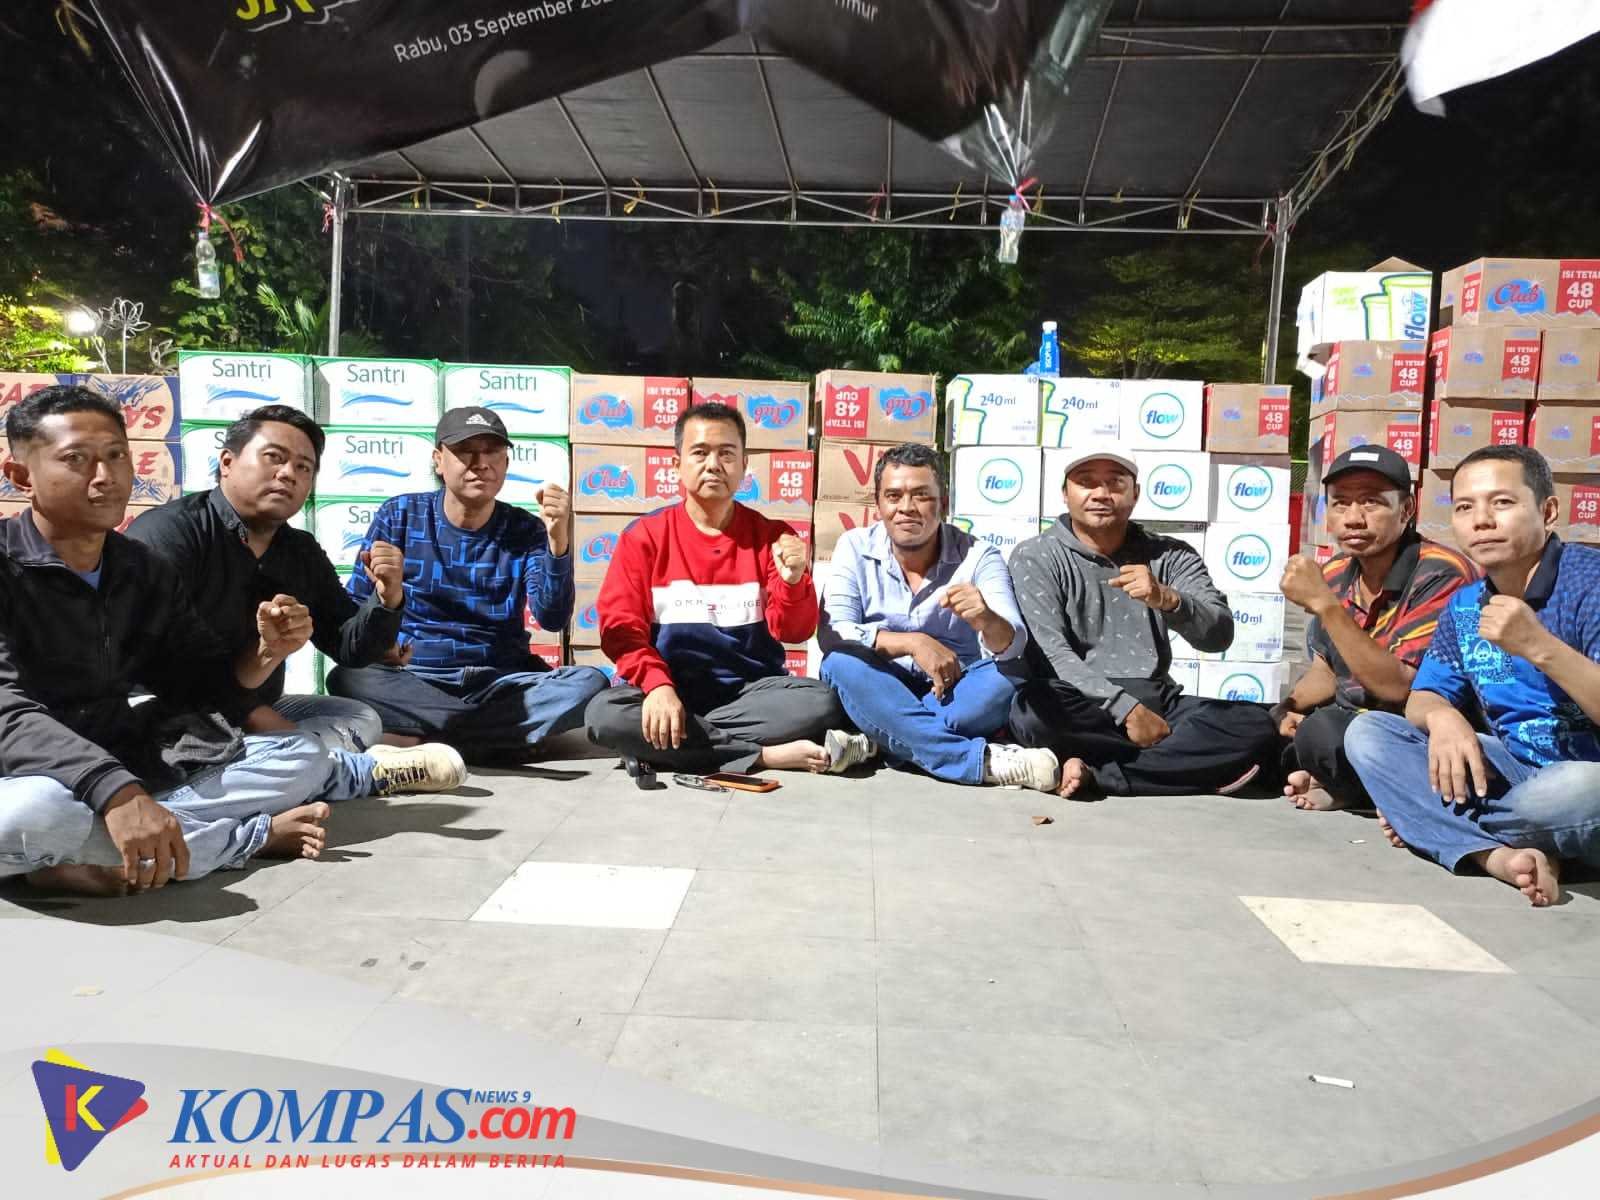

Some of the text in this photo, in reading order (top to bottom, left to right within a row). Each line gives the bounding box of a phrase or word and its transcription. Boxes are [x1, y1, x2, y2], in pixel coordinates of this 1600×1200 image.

[393, 0, 573, 63] Rabu, 03 September
[1566, 281, 1594, 298] 48
[1567, 299, 1593, 309] CUP
[1404, 290, 1427, 340] flow
[1509, 354, 1531, 367] 48
[212, 358, 272, 380] Santri
[347, 363, 405, 384] Santri
[1398, 368, 1418, 380] 48
[1511, 366, 1530, 374] CUP
[479, 370, 537, 391] Santri
[1399, 379, 1418, 387] CUP
[835, 391, 859, 401] CUP
[652, 398, 679, 414] 48
[834, 401, 860, 417] 48
[654, 415, 679, 424] CUP
[1146, 410, 1179, 426] flow
[1264, 411, 1283, 424] 48
[1497, 427, 1518, 439] 48
[345, 435, 403, 455] Santri
[511, 443, 537, 462] ntri
[1393, 438, 1413, 451] 48
[654, 467, 680, 484] 48
[778, 471, 803, 488] 48
[985, 475, 1017, 491] flow
[656, 484, 680, 494] CUP
[780, 488, 803, 497] CUP
[1153, 480, 1186, 496] flow
[1234, 482, 1268, 498] flow
[1576, 500, 1598, 512] 48
[1577, 511, 1596, 519] CUP
[1232, 551, 1265, 566] flow
[1233, 609, 1263, 625] 40ml
